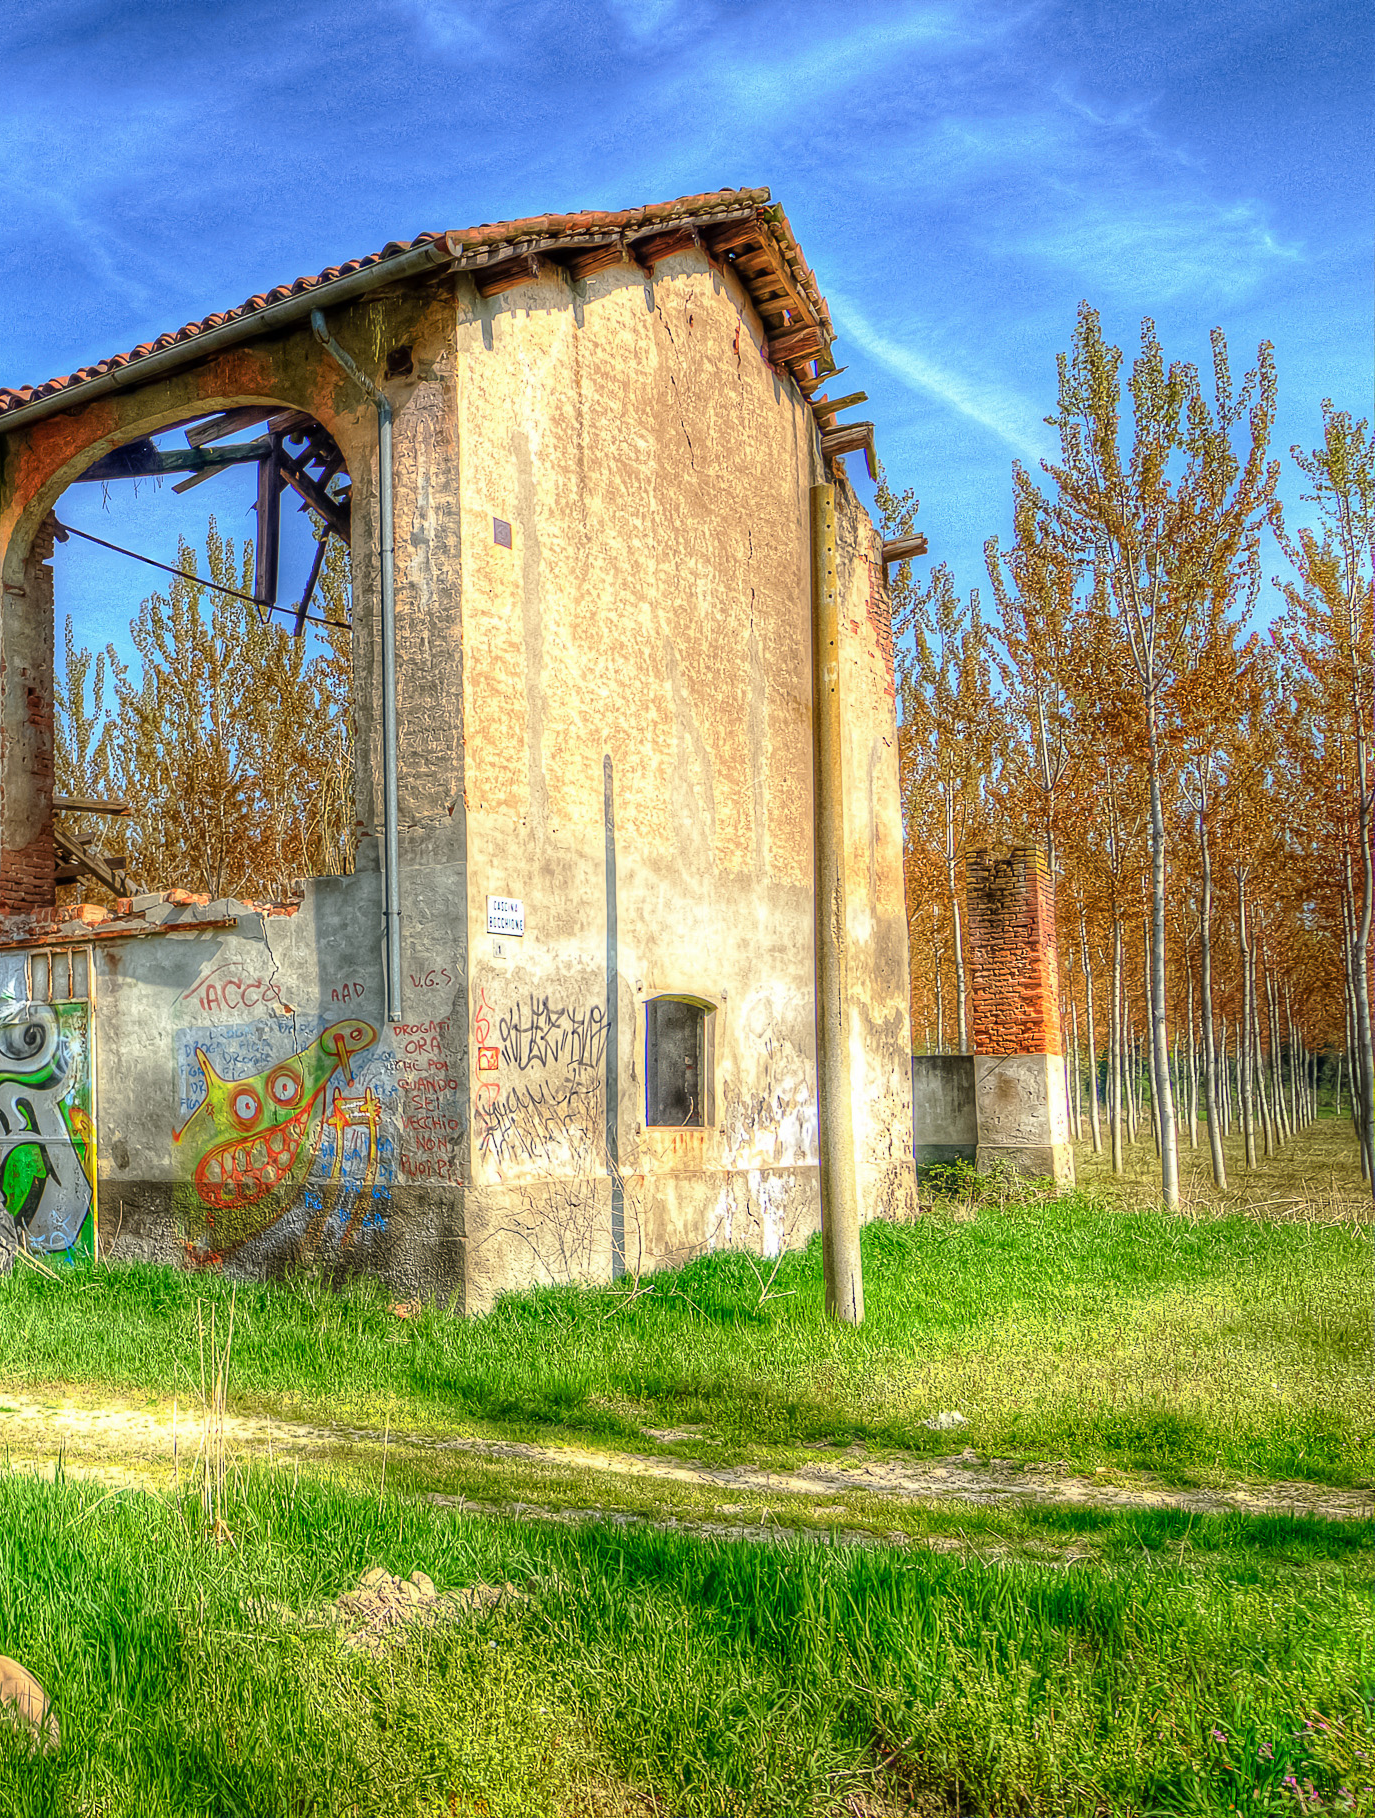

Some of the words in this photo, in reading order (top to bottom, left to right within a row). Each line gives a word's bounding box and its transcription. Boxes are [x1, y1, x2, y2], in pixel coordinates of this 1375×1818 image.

[489, 916, 523, 931] BOCCHIONE
[404, 1036, 442, 1056] ORA
[428, 1055, 449, 1072] POI
[397, 1077, 458, 1094] QUANDO
[411, 1094, 440, 1112] SEI
[415, 1136, 448, 1153] NON
